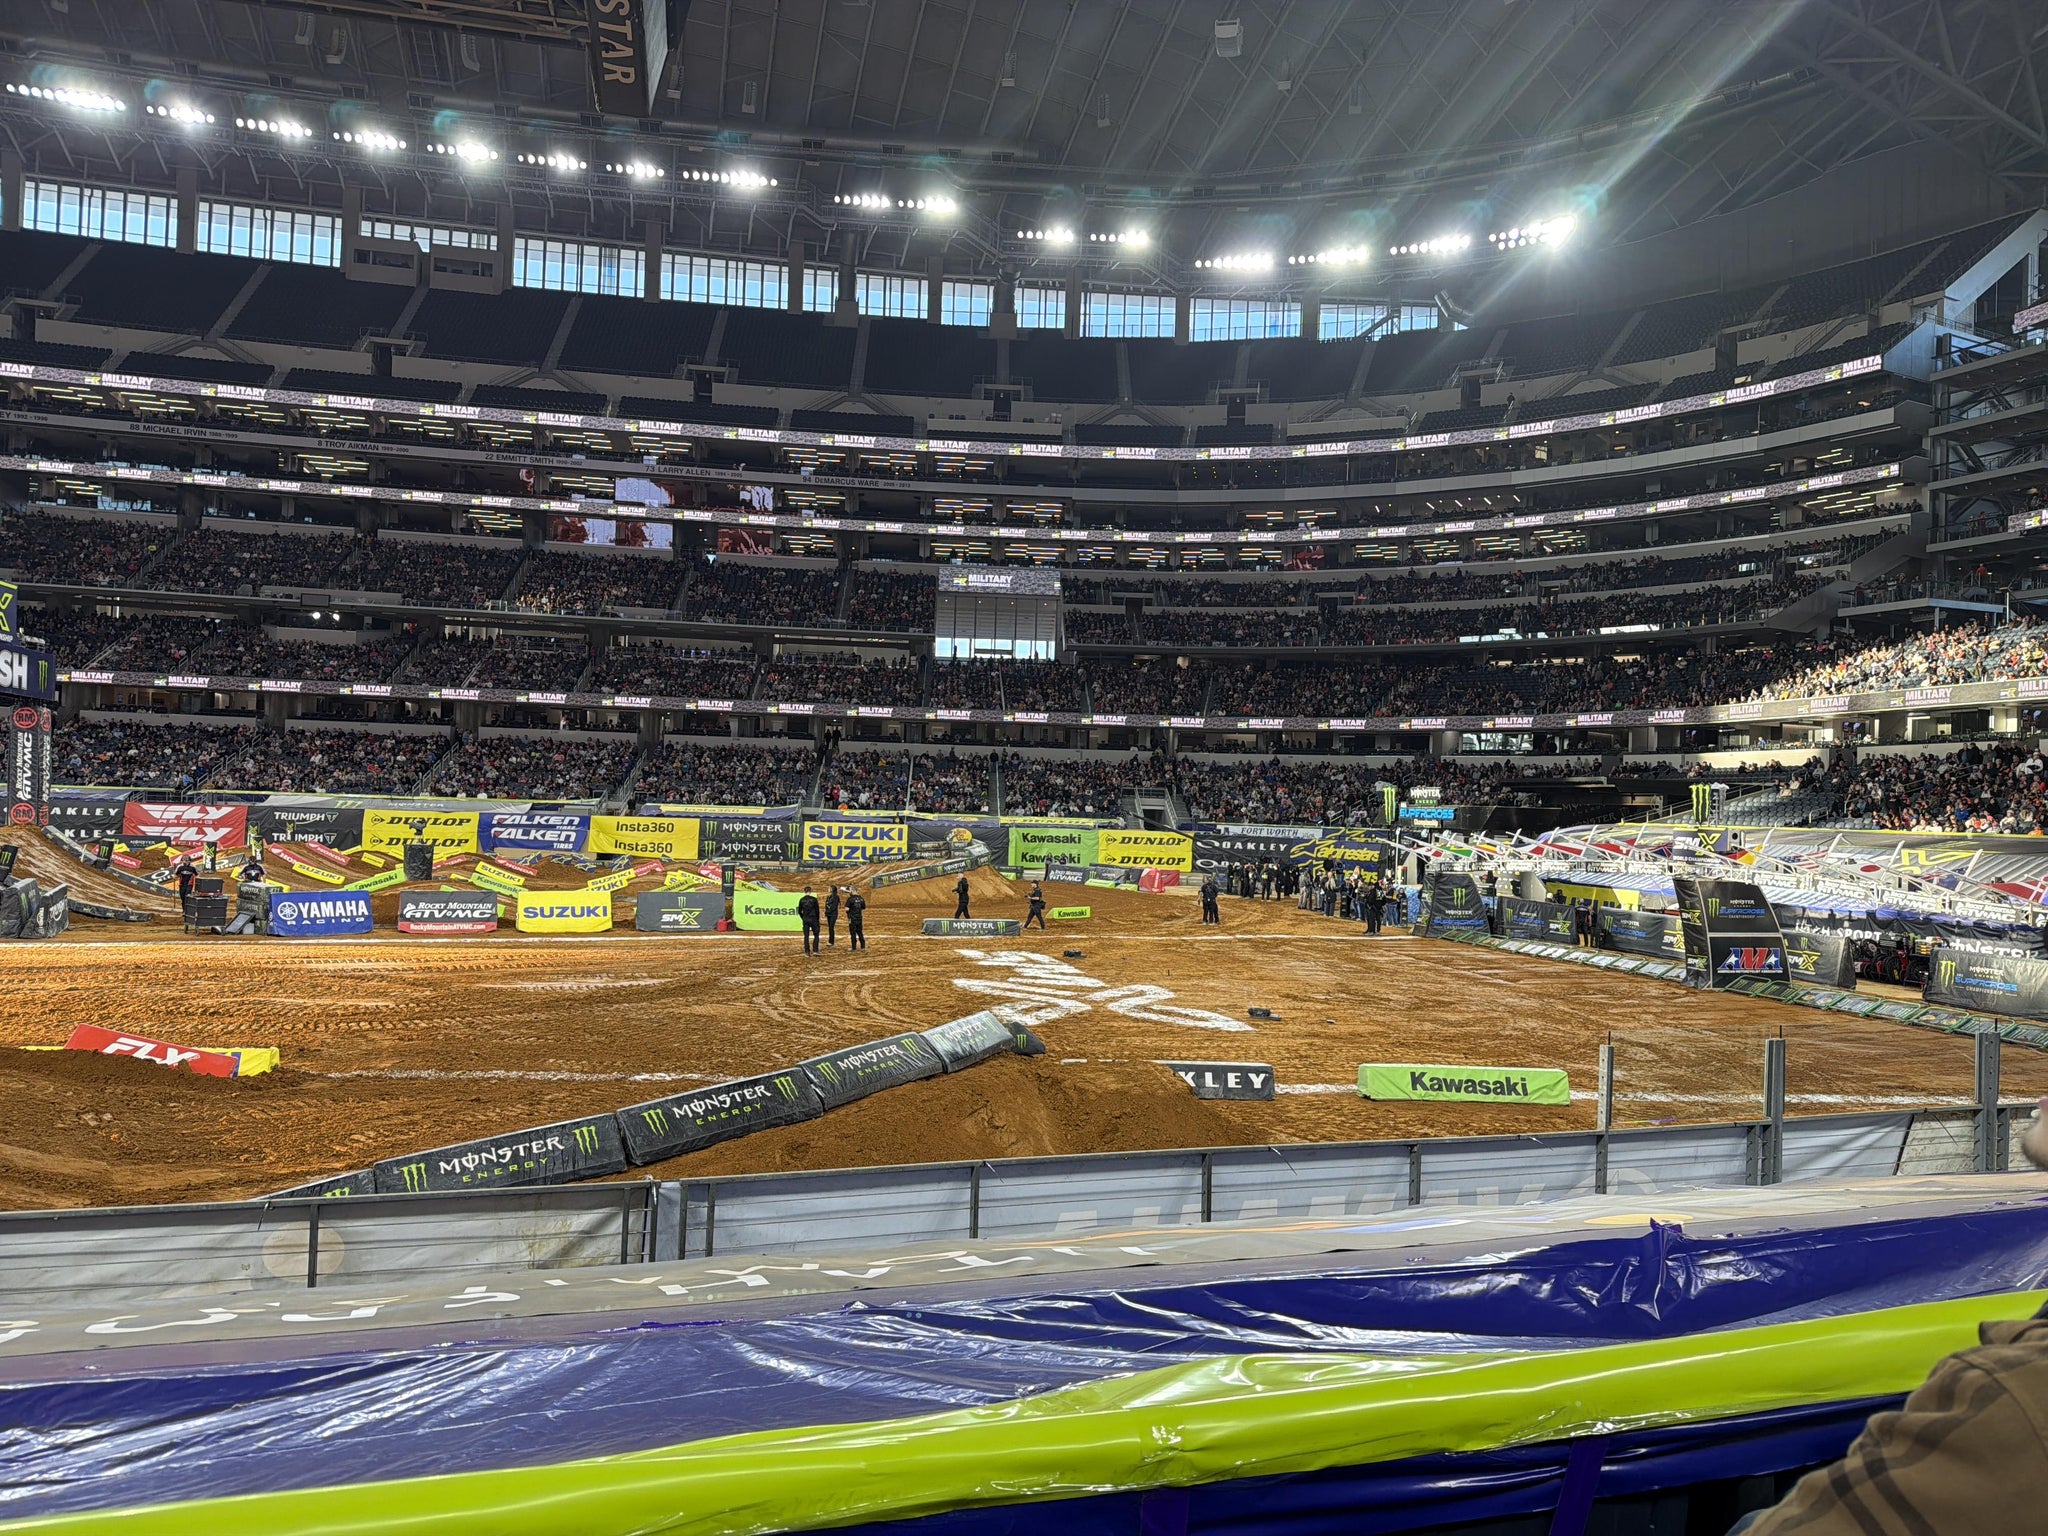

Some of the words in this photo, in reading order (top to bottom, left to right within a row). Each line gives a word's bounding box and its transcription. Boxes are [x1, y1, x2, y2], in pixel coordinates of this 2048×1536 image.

[595, 0, 636, 84] STAR
[1842, 354, 1881, 373] MILITA
[101, 372, 154, 386] MILITARY
[217, 384, 267, 397] MILITARY
[1726, 381, 1777, 399] MILITARY
[328, 394, 376, 406] MILITARY
[433, 404, 481, 415] MILITARY
[1615, 403, 1664, 419] MILITARY
[537, 412, 584, 423] MILITARY
[143, 424, 182, 435] MICHAEL
[184, 429, 207, 437] IRVIN
[639, 420, 684, 431] MILITARY
[1509, 420, 1556, 434] MILITARY
[738, 428, 781, 438] MILITARY
[834, 434, 877, 444] MILITARY
[929, 439, 971, 449] MILITARY
[1406, 433, 1451, 445] MILITARY
[325, 440, 346, 449] TROY
[348, 442, 379, 451] AIKMAN
[1022, 444, 1064, 453] MILITARY
[1116, 446, 1158, 455] MILITARY
[1209, 447, 1253, 455] MILITARY
[1306, 442, 1350, 451] MILITARY
[38, 461, 73, 469] MILITARY
[496, 454, 526, 463] EMMITT
[530, 457, 554, 465] SMITH
[117, 467, 151, 475] MILITARY
[657, 466, 686, 475] LARRY
[686, 468, 711, 477] ALLEN
[194, 474, 227, 482] MILITARY
[857, 479, 880, 487] WARE
[1808, 475, 1844, 487] MILITARY
[269, 480, 301, 488] MILITARY
[341, 486, 372, 494] MILITARY
[412, 491, 444, 499] MILITARY
[1731, 487, 1767, 497] MILITARY
[481, 496, 512, 504] MILITARY
[1656, 498, 1690, 508] MILITARY
[1584, 507, 1617, 517] MILITARY
[1444, 521, 1476, 529] MILITARY
[1514, 515, 1545, 524] MILITARY
[968, 574, 1013, 584] MILITARY
[71, 671, 114, 680] MILITARY
[168, 676, 210, 685] MILITARY
[261, 680, 302, 688] MILITARY
[352, 684, 392, 693] MILITARY
[529, 692, 567, 700] MILITARY
[614, 696, 652, 704] MILITARY
[1904, 688, 1952, 701] MILITARY
[779, 703, 815, 711] MILITARY
[1810, 696, 1850, 708] MILITARY
[858, 706, 893, 714] MILITARY
[936, 709, 971, 717] MILITARY
[1729, 705, 1763, 715] MILITARY
[1092, 714, 1127, 722] MILITARY
[1170, 717, 1205, 725] MILITARY
[1411, 718, 1447, 726] MILITARY
[1577, 713, 1614, 721] MILITARY
[1410, 788, 1441, 799] MONSTER
[50, 807, 119, 816] AKLEY
[140, 804, 236, 819] FLY
[274, 811, 325, 821] TRIUMPH
[1400, 808, 1455, 819] SUPERCROSS
[491, 814, 580, 825] FALKEN
[616, 821, 675, 834] Insta360
[722, 821, 783, 833] MONSTER
[808, 825, 903, 840] SUZUKI
[1241, 827, 1263, 835] FORT
[1266, 828, 1298, 836] WORTH
[490, 827, 577, 841] FALKEN
[1021, 832, 1082, 844] Kawasaki
[553, 842, 574, 850] TIRES
[1119, 836, 1187, 846] DUNLOP
[1222, 842, 1289, 851] OAKLEY
[1674, 833, 1720, 856] SMX
[614, 840, 673, 854] Insta360
[721, 841, 782, 853] MONSTER
[1316, 845, 1379, 862] alpinestars
[1118, 856, 1187, 866] DUNLOP
[298, 864, 341, 881] SUZUKI
[481, 864, 521, 882] SUZUKI
[300, 900, 369, 918] YAMAHA
[418, 902, 446, 910] ROCKY
[447, 902, 492, 910] MOUNTAIN
[523, 906, 608, 919] SUZUKI
[661, 911, 701, 925] SMX
[1058, 909, 1087, 918] Kawasaki
[1682, 911, 1700, 923] SMX
[287, 917, 365, 926] RACING
[410, 922, 486, 931] RockyMountainATVMC.com
[953, 921, 994, 930] MONSTER
[1662, 935, 1686, 949] SMX
[1717, 947, 1783, 970] AMA
[1969, 965, 2004, 976] MONSTER
[1955, 976, 2018, 992] SUPERCROSS
[1965, 986, 2004, 996] CHAMPIONSHIP
[102, 1037, 200, 1066] FLY
[836, 1044, 901, 1072] MONSTER
[856, 1058, 899, 1077] ENERGY
[1177, 1071, 1266, 1089] KLEY
[1409, 1071, 1529, 1097] Kawasaki
[672, 1084, 773, 1120] MONSTER
[695, 1102, 763, 1126] ENERGY
[439, 1135, 567, 1178] MONSTER
[463, 1157, 550, 1184] ENERGY
